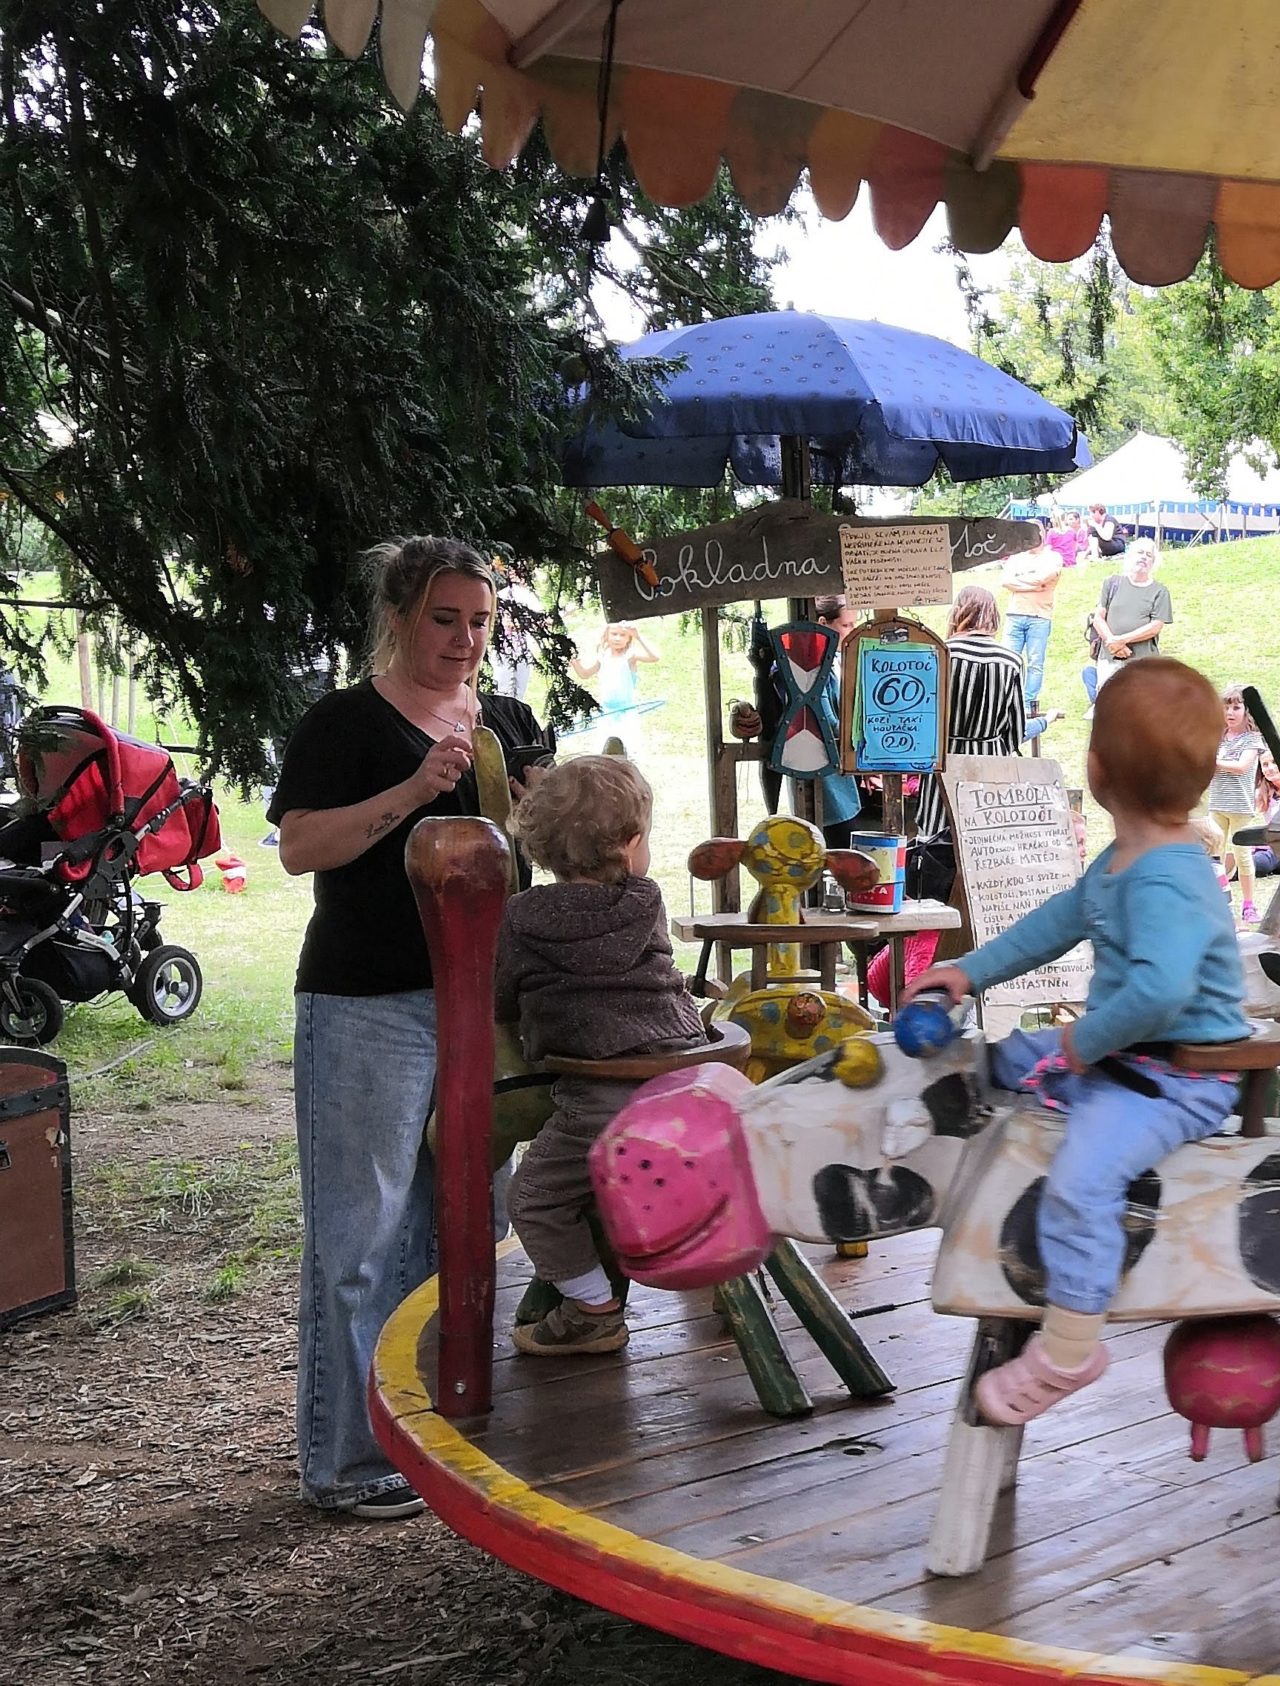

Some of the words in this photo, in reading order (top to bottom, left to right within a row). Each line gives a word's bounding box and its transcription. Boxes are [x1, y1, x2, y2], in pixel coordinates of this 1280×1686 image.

[969, 786, 1051, 809] TOMBOLA
[964, 817, 977, 827] NA
[983, 805, 1052, 825] KOLOTOČI
